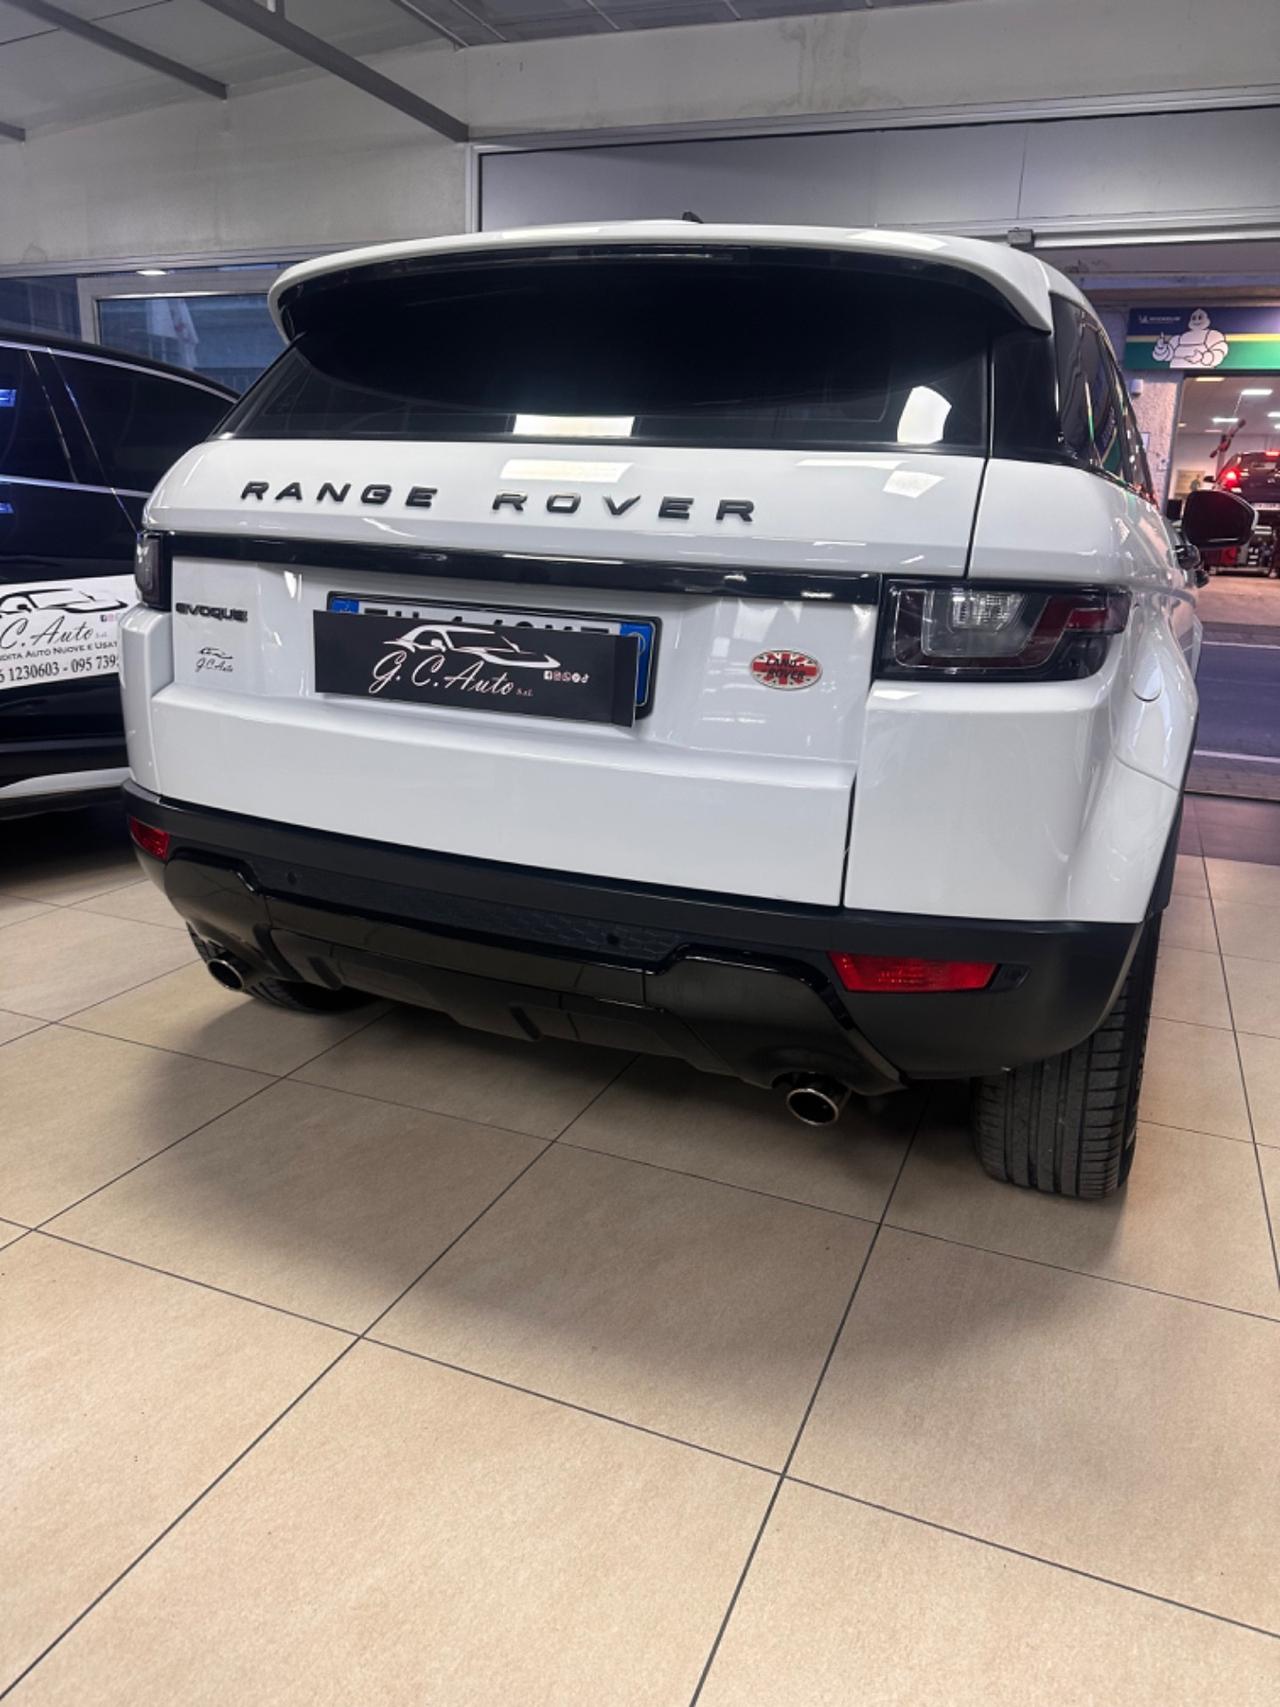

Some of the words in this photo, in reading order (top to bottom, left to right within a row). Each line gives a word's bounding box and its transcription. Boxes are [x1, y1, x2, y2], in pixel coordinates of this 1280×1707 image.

[240, 481, 437, 508] RANGE
[492, 491, 755, 523] ROVER
[175, 602, 248, 623] EVOQUE
[30, 615, 94, 646] Auto
[9, 661, 60, 681] 1230603
[71, 657, 92, 673] 095
[96, 654, 119, 669] 739
[443, 661, 514, 696] Auto
